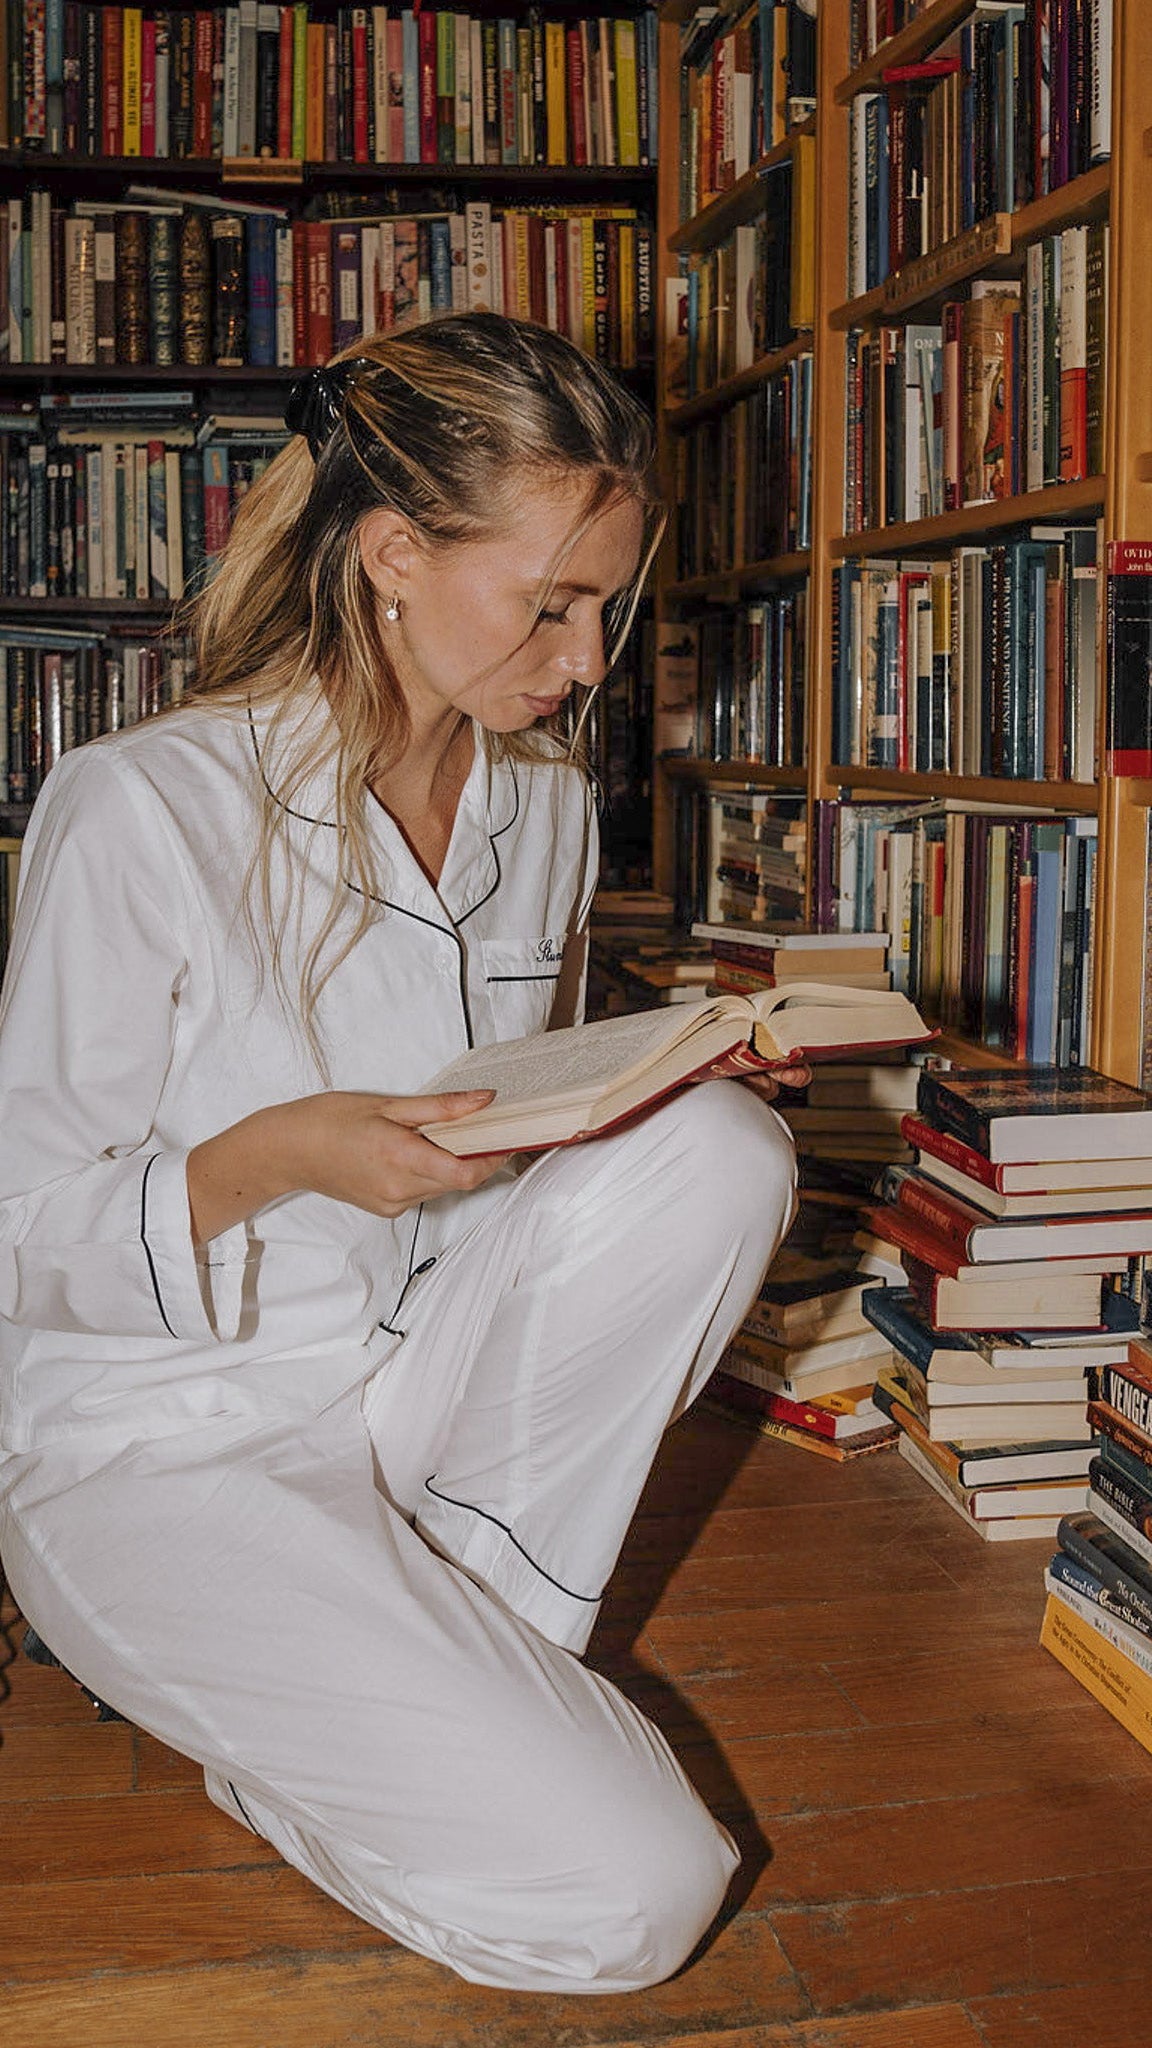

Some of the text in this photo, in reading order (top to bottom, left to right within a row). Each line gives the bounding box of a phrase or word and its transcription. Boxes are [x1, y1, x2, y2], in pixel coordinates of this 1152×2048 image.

[471, 211, 485, 260] PASTA
[638, 241, 650, 314] RUSTICA
[1126, 562, 1143, 572] John
[1002, 576, 1012, 737] PRAYER AND PENITENCE
[1098, 1474, 1114, 1496] THE
[1114, 1486, 1135, 1514] BIBLE
[1061, 1567, 1086, 1594] Sound
